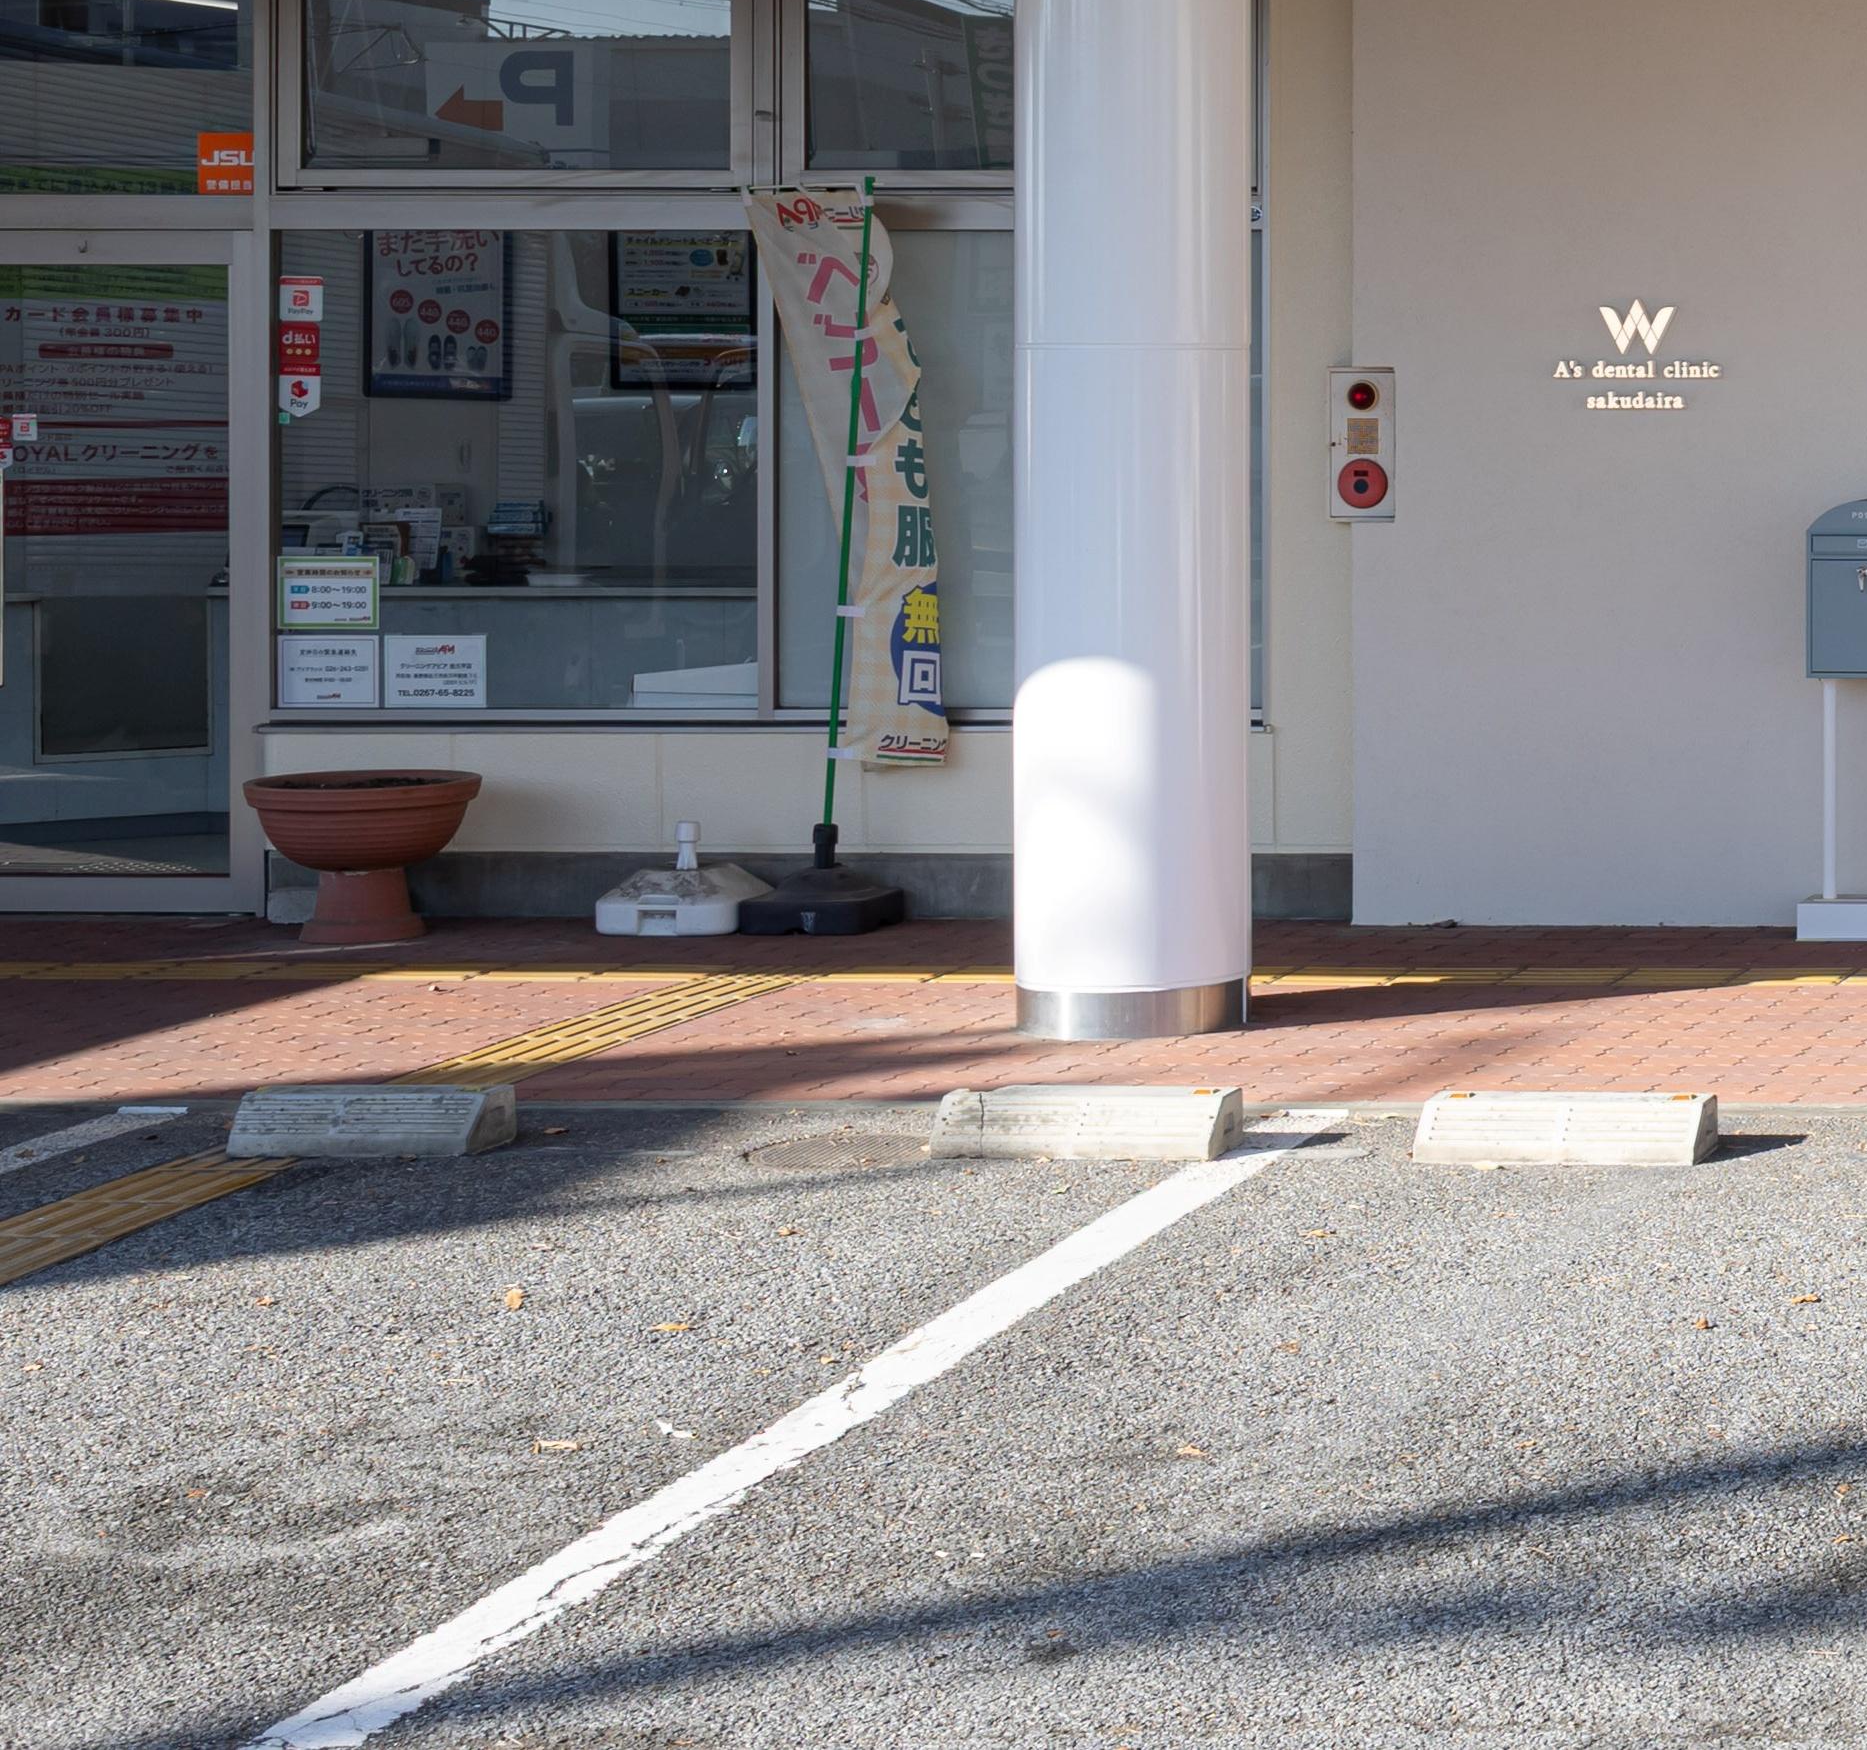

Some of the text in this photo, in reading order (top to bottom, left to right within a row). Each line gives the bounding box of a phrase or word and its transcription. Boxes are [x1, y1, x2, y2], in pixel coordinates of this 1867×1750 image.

[1552, 360, 1722, 379] A's dental clinic
[290, 398, 309, 409] Pay
[1586, 390, 1685, 410] sakudaira
